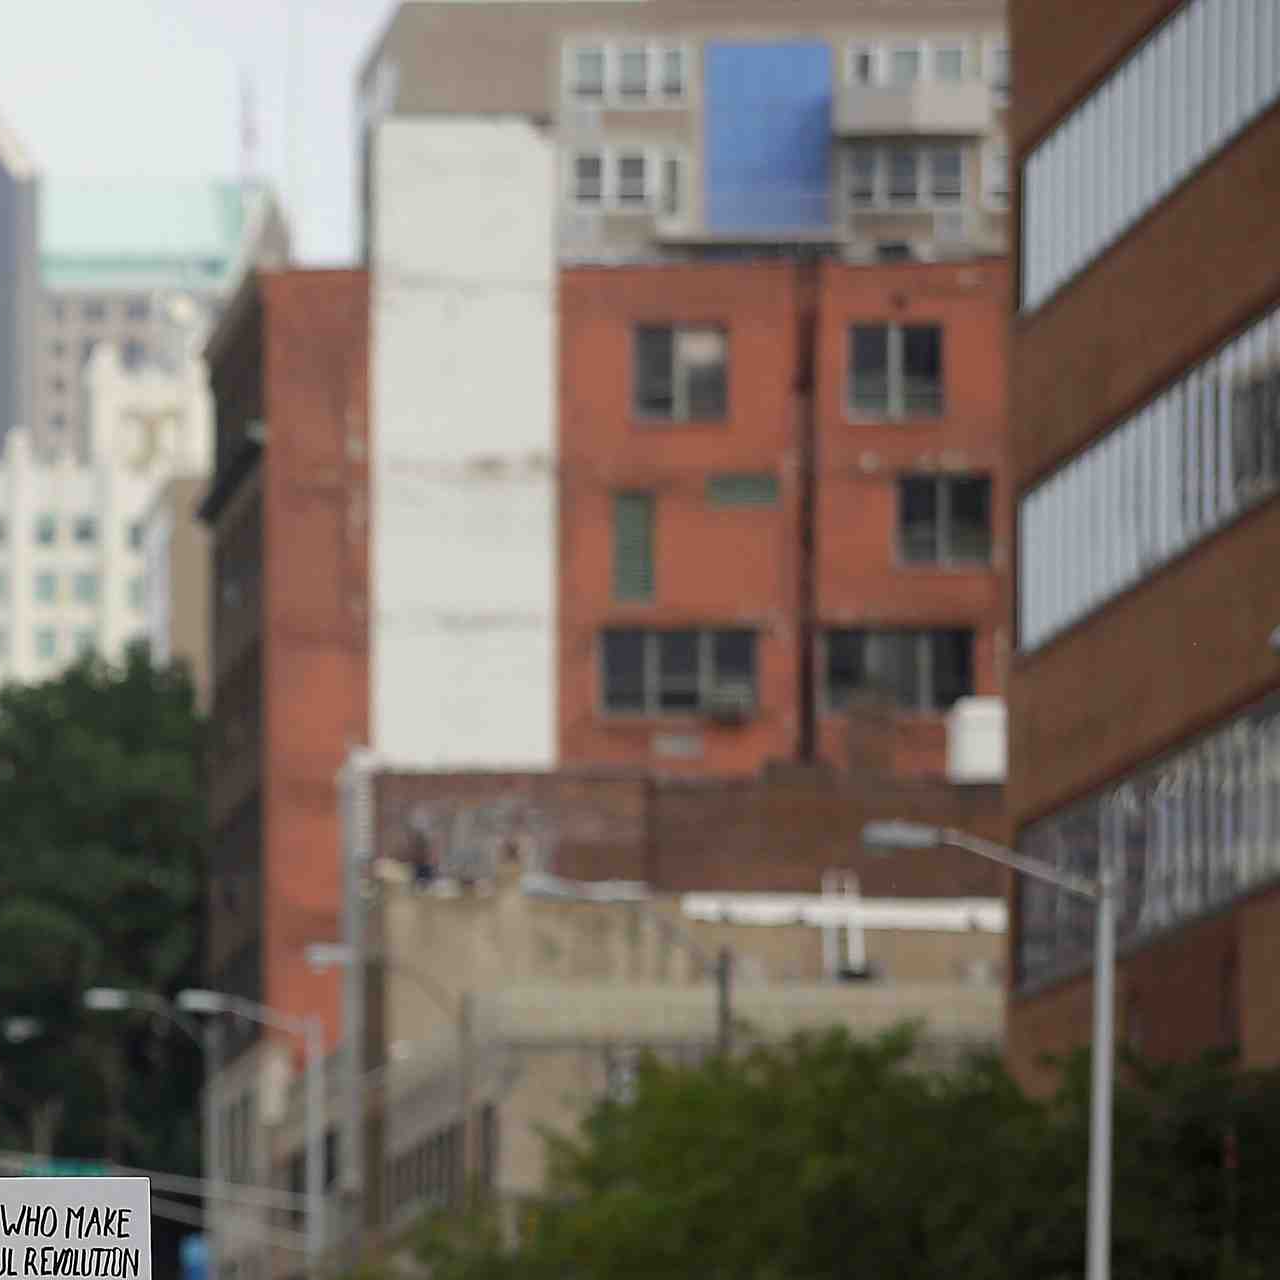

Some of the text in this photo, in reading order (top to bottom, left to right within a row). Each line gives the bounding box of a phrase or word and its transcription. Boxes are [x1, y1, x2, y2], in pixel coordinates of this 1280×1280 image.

[0, 1204, 58, 1238] WHO
[65, 1206, 131, 1239] MAKE
[24, 1247, 139, 1278] REVOLUTION
